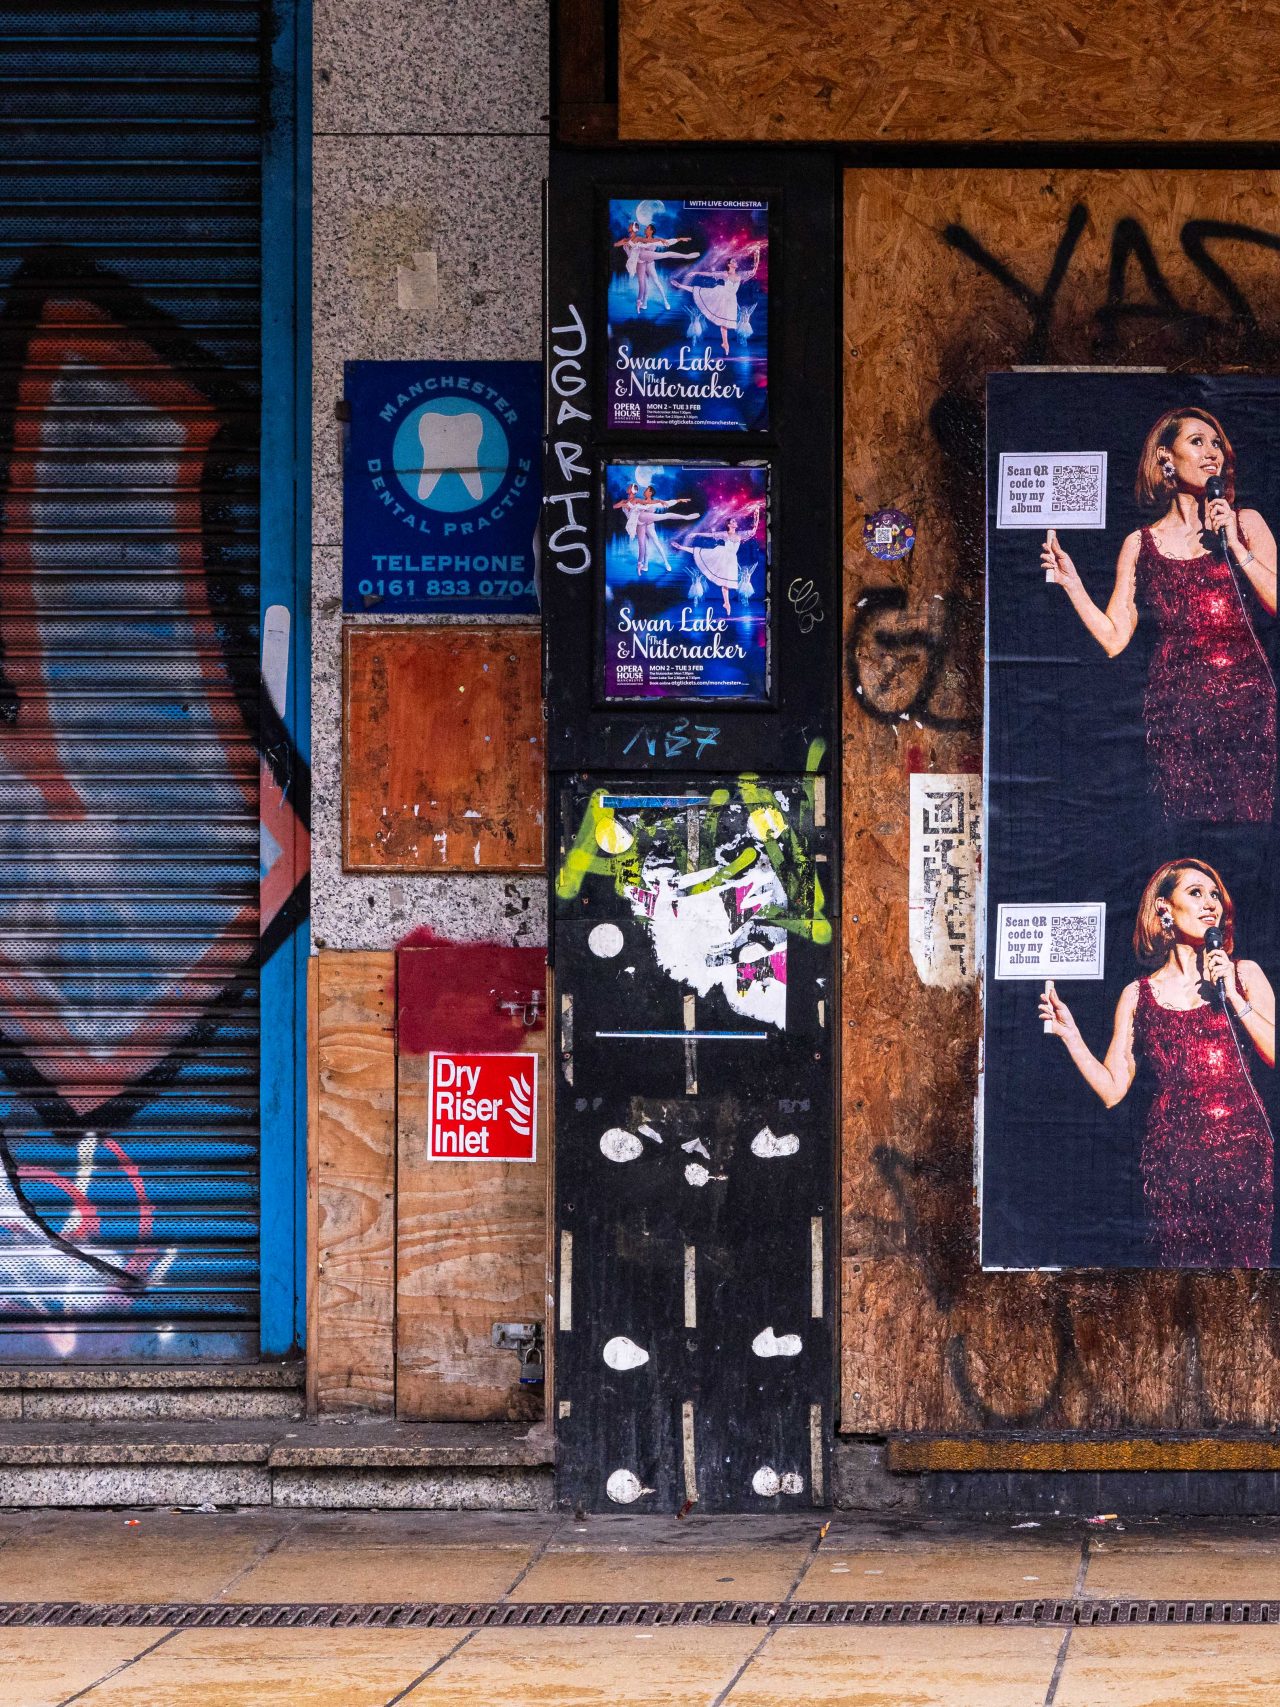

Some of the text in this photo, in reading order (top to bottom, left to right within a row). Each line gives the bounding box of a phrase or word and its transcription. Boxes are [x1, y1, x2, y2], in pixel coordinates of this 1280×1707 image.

[616, 345, 726, 372] Swan Lake
[615, 379, 627, 397] &
[628, 371, 744, 399] Nutcracker
[379, 376, 518, 424] MANCHESTER
[1007, 465, 1049, 476] Scan QR
[1009, 478, 1045, 488] code to
[367, 457, 531, 536] DENTAL PRACTICE
[1009, 490, 1045, 501] buy my
[1011, 503, 1042, 513] album
[371, 555, 526, 572] TELEPHONE
[358, 580, 537, 596] 0161 833 0704
[618, 607, 728, 632] Swan Lake
[617, 641, 630, 659] &
[631, 633, 746, 659] Nutcracker
[1005, 916, 1047, 927] Scan QR
[1008, 929, 1044, 939] code to
[1008, 941, 1043, 953] buy my
[1009, 954, 1040, 964] album
[436, 1058, 482, 1096] Dry
[436, 1091, 503, 1122] Riser
[434, 1123, 490, 1154] Inlet
